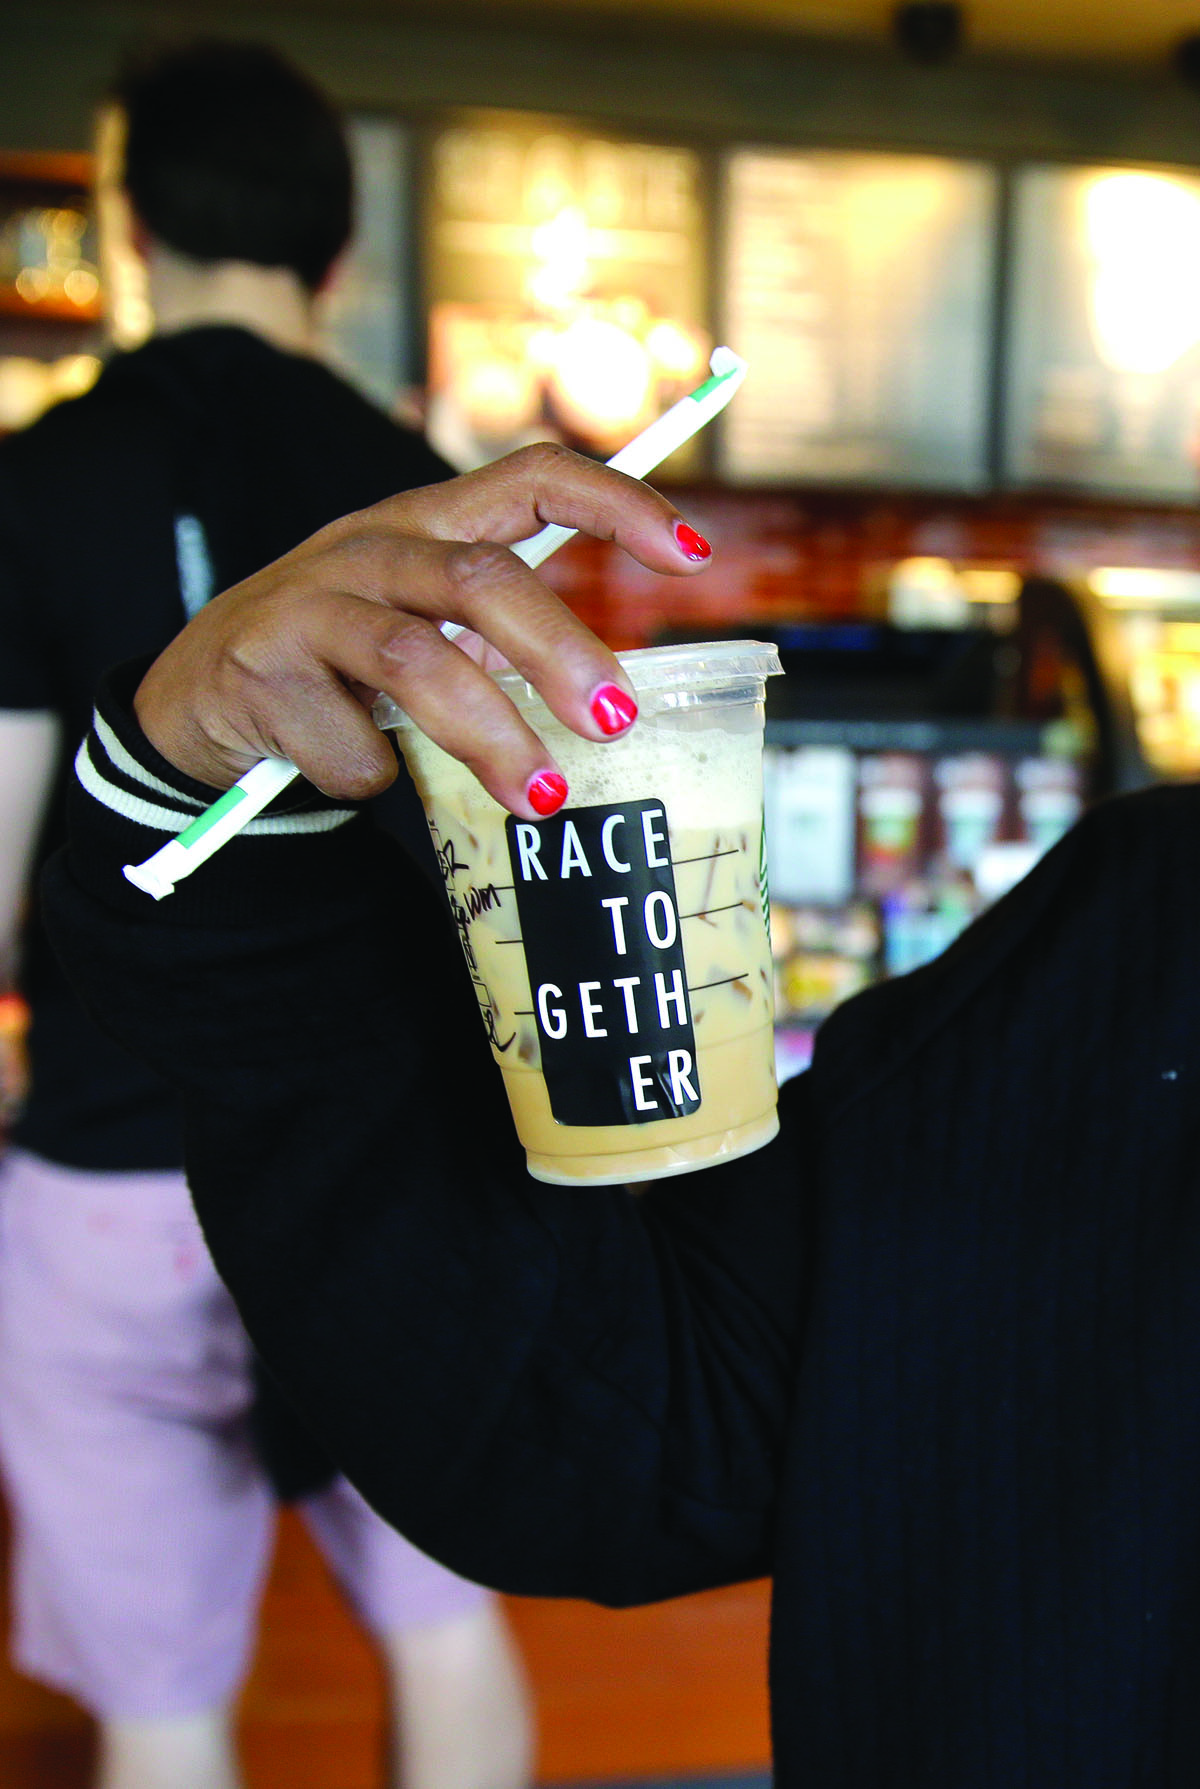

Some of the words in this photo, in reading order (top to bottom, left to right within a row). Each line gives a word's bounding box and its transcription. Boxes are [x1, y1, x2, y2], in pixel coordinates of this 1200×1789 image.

[515, 809, 669, 881] RACE
[602, 890, 677, 955] TO
[537, 969, 688, 1039] GETH
[629, 1049, 699, 1111] ER
